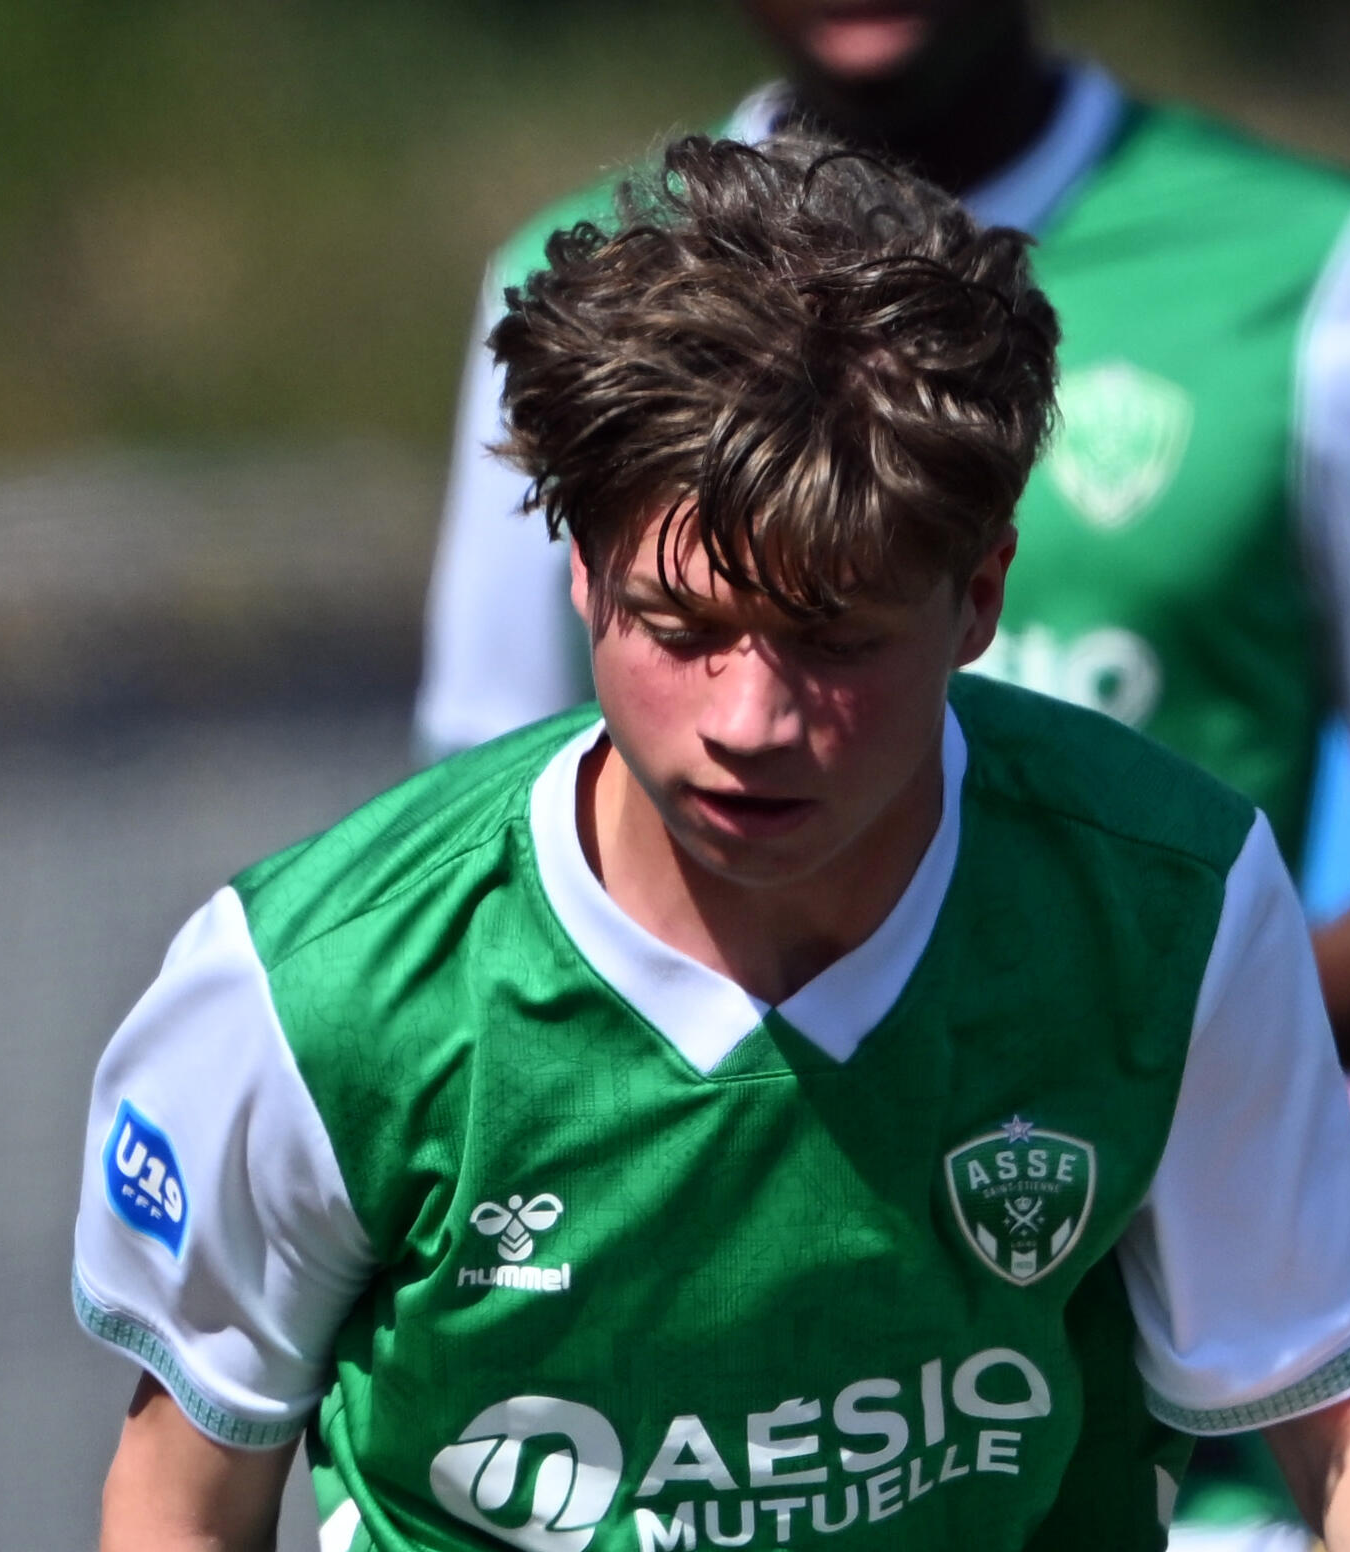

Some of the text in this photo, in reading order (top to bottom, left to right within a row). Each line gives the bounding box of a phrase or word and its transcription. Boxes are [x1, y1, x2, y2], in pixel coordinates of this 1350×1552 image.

[116, 1122, 183, 1223] U19
[967, 1149, 1077, 1190] ASSE
[457, 1263, 570, 1291] hummel
[635, 1347, 1050, 1497] AÉSIO
